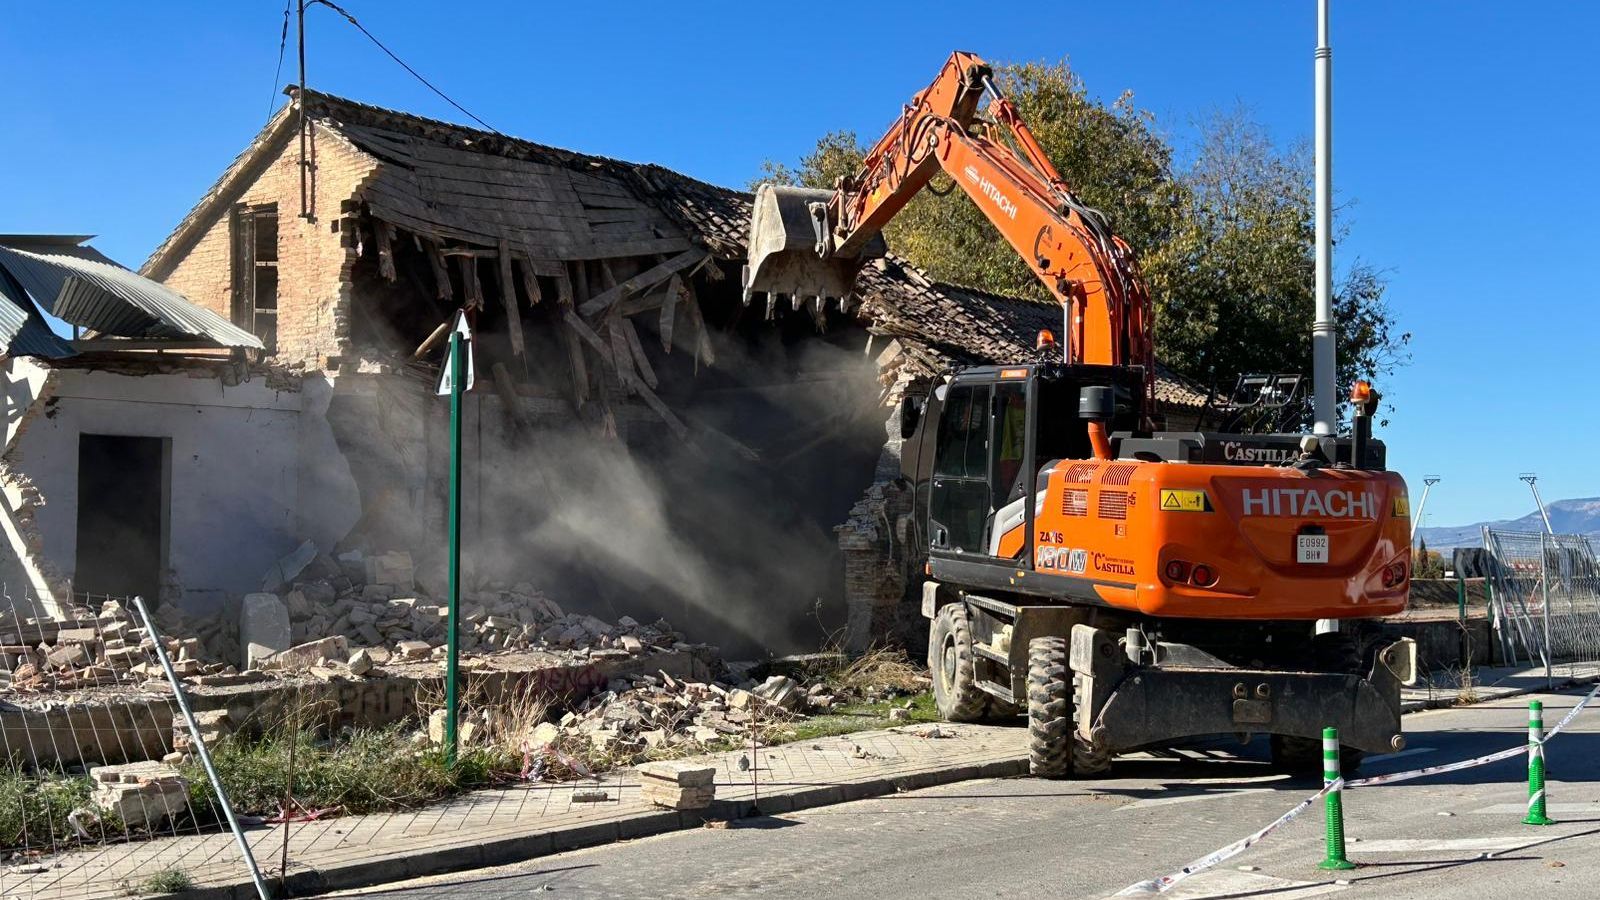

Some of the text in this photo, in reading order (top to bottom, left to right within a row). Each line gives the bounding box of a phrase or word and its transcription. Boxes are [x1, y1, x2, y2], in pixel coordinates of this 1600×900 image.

[980, 176, 1017, 219] HITACHI
[1242, 488, 1376, 519] HITACHI
[1299, 537, 1326, 548] E0992
